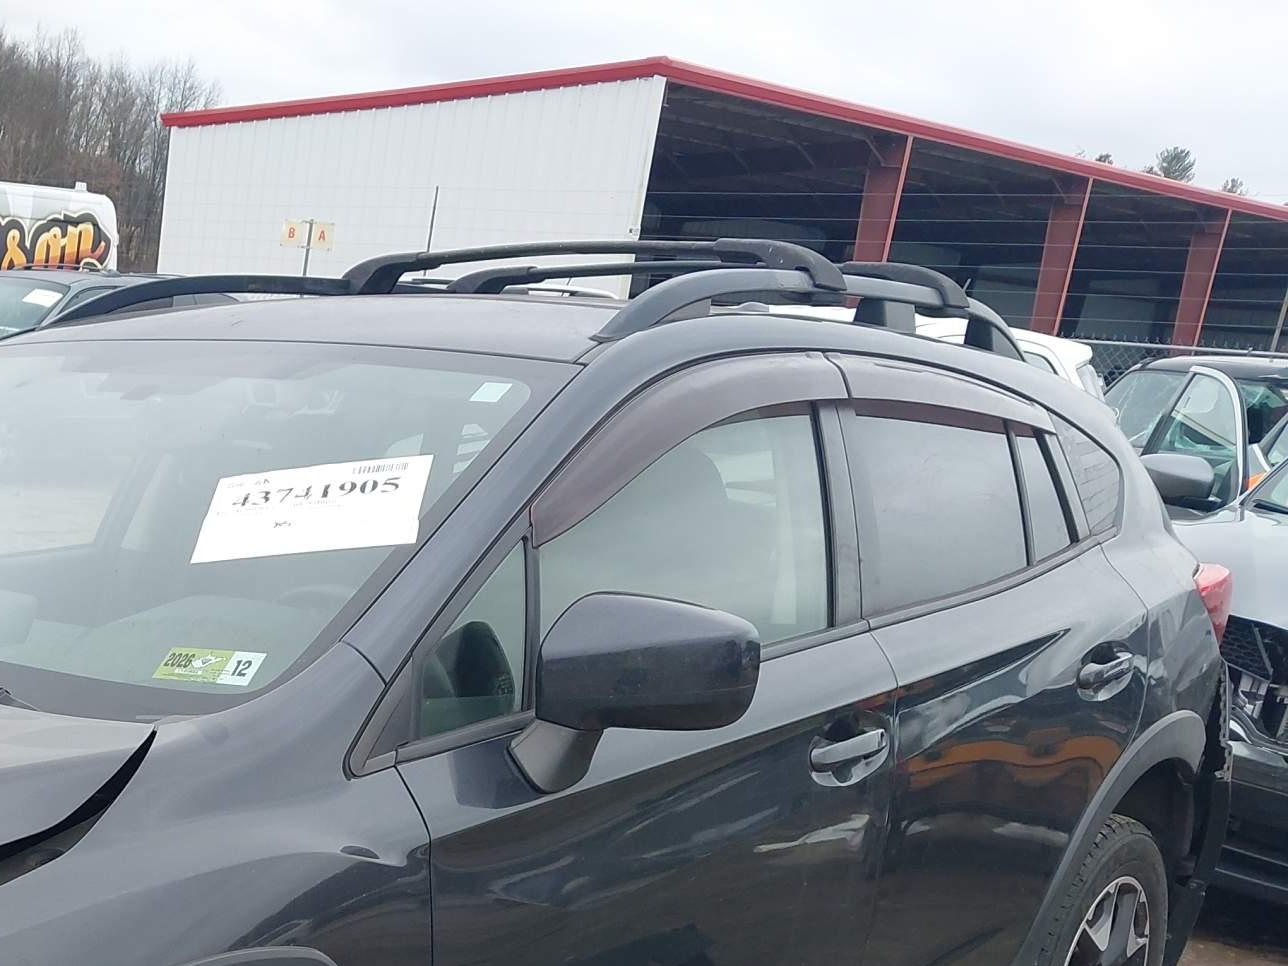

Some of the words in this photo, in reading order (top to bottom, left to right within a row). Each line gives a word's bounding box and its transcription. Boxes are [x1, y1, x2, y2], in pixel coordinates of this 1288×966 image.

[318, 229, 326, 241] A
[231, 476, 401, 507] 43741905
[163, 652, 196, 669] 2026
[231, 659, 253, 677] 12
